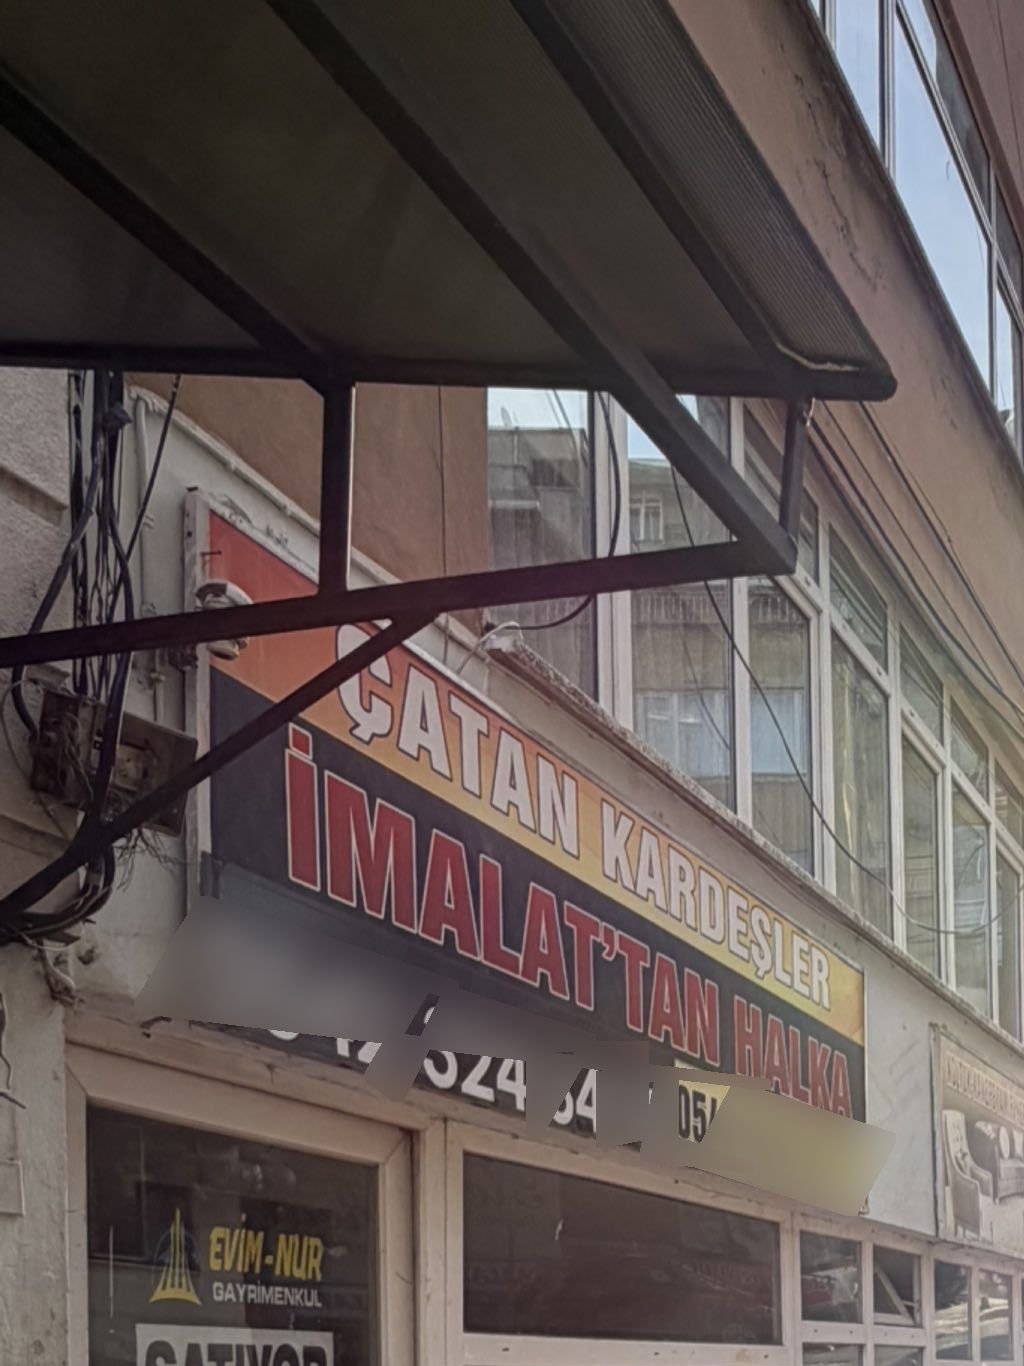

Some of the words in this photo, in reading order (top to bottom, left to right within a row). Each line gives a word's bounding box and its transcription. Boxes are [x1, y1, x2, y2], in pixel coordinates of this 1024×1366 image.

[284, 721, 720, 1067] İMALAT'TAN
[733, 994, 854, 1118] HALKA
[336, 619, 580, 860] ÇATAN
[601, 798, 831, 1012] KARDEŞLER
[212, 1280, 323, 1308] GAYRİMENKUL
